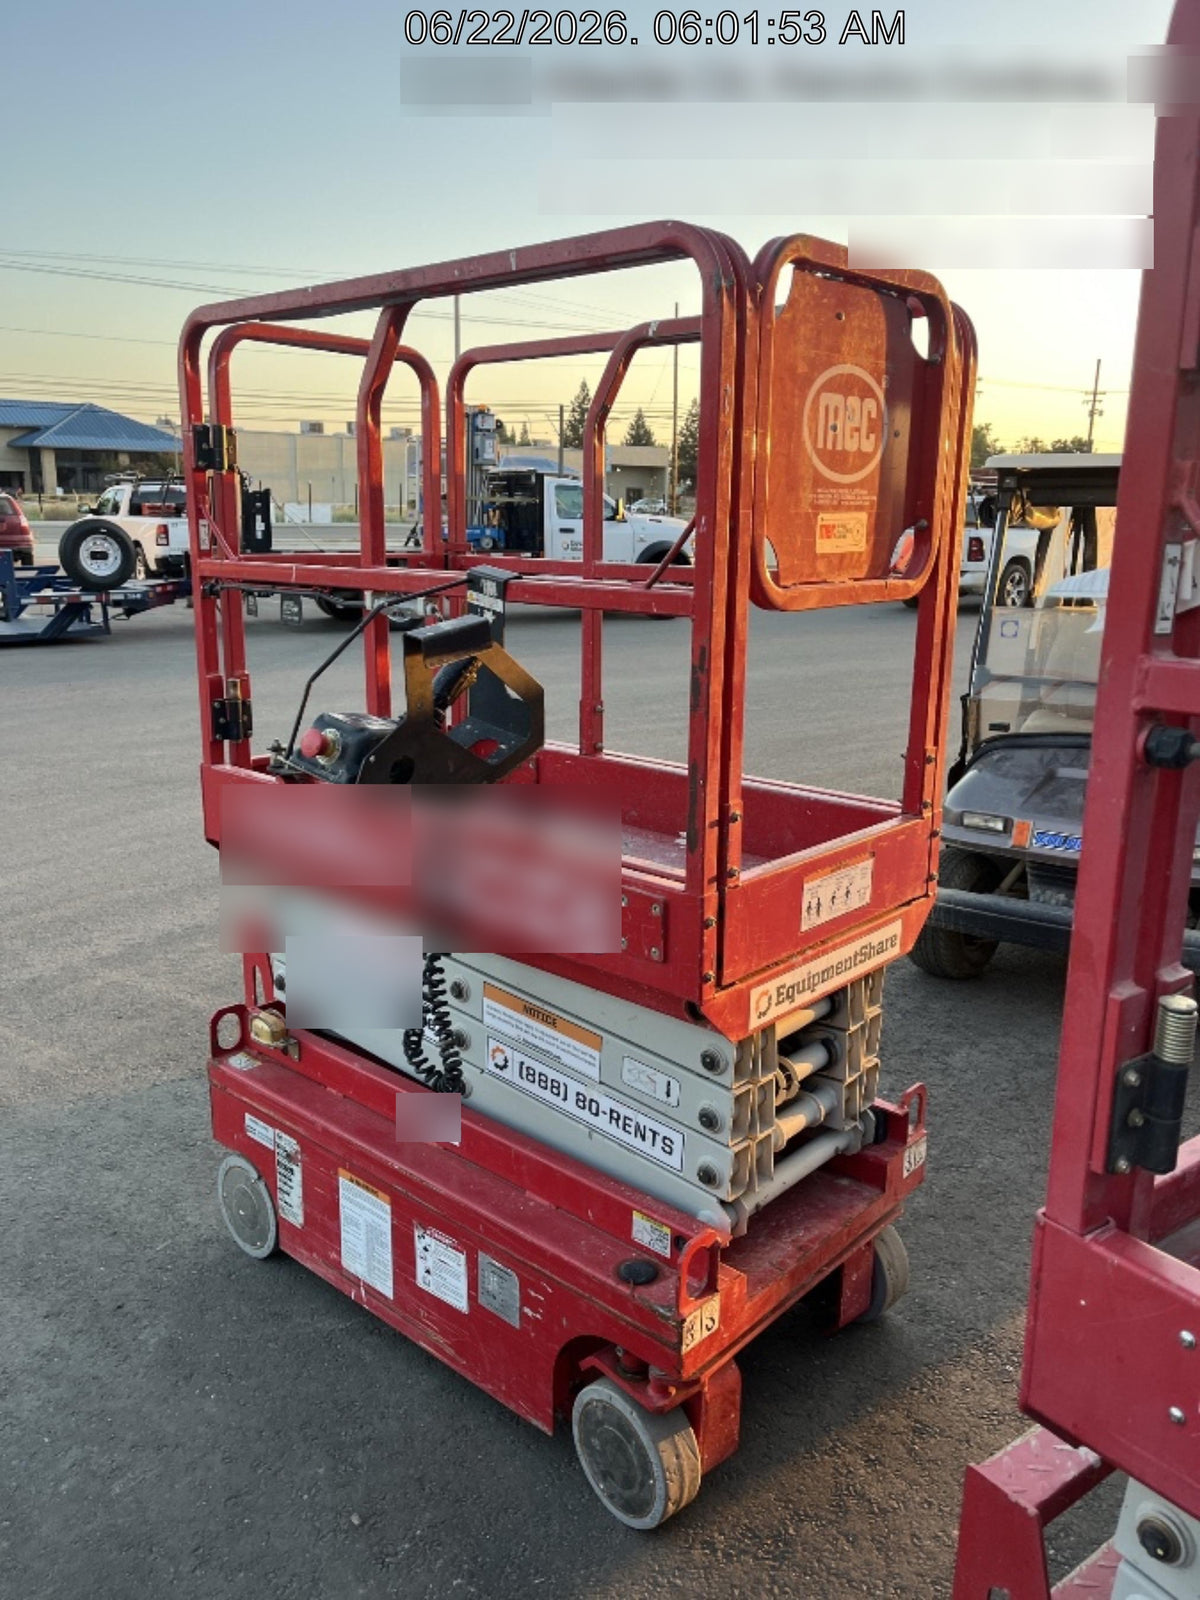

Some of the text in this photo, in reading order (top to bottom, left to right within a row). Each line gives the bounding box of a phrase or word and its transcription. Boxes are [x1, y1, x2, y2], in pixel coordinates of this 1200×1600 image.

[774, 932, 898, 1007] EquipmentShare
[522, 1004, 558, 1029] NOTICE
[518, 1060, 675, 1157] (888) 80-RENTS
